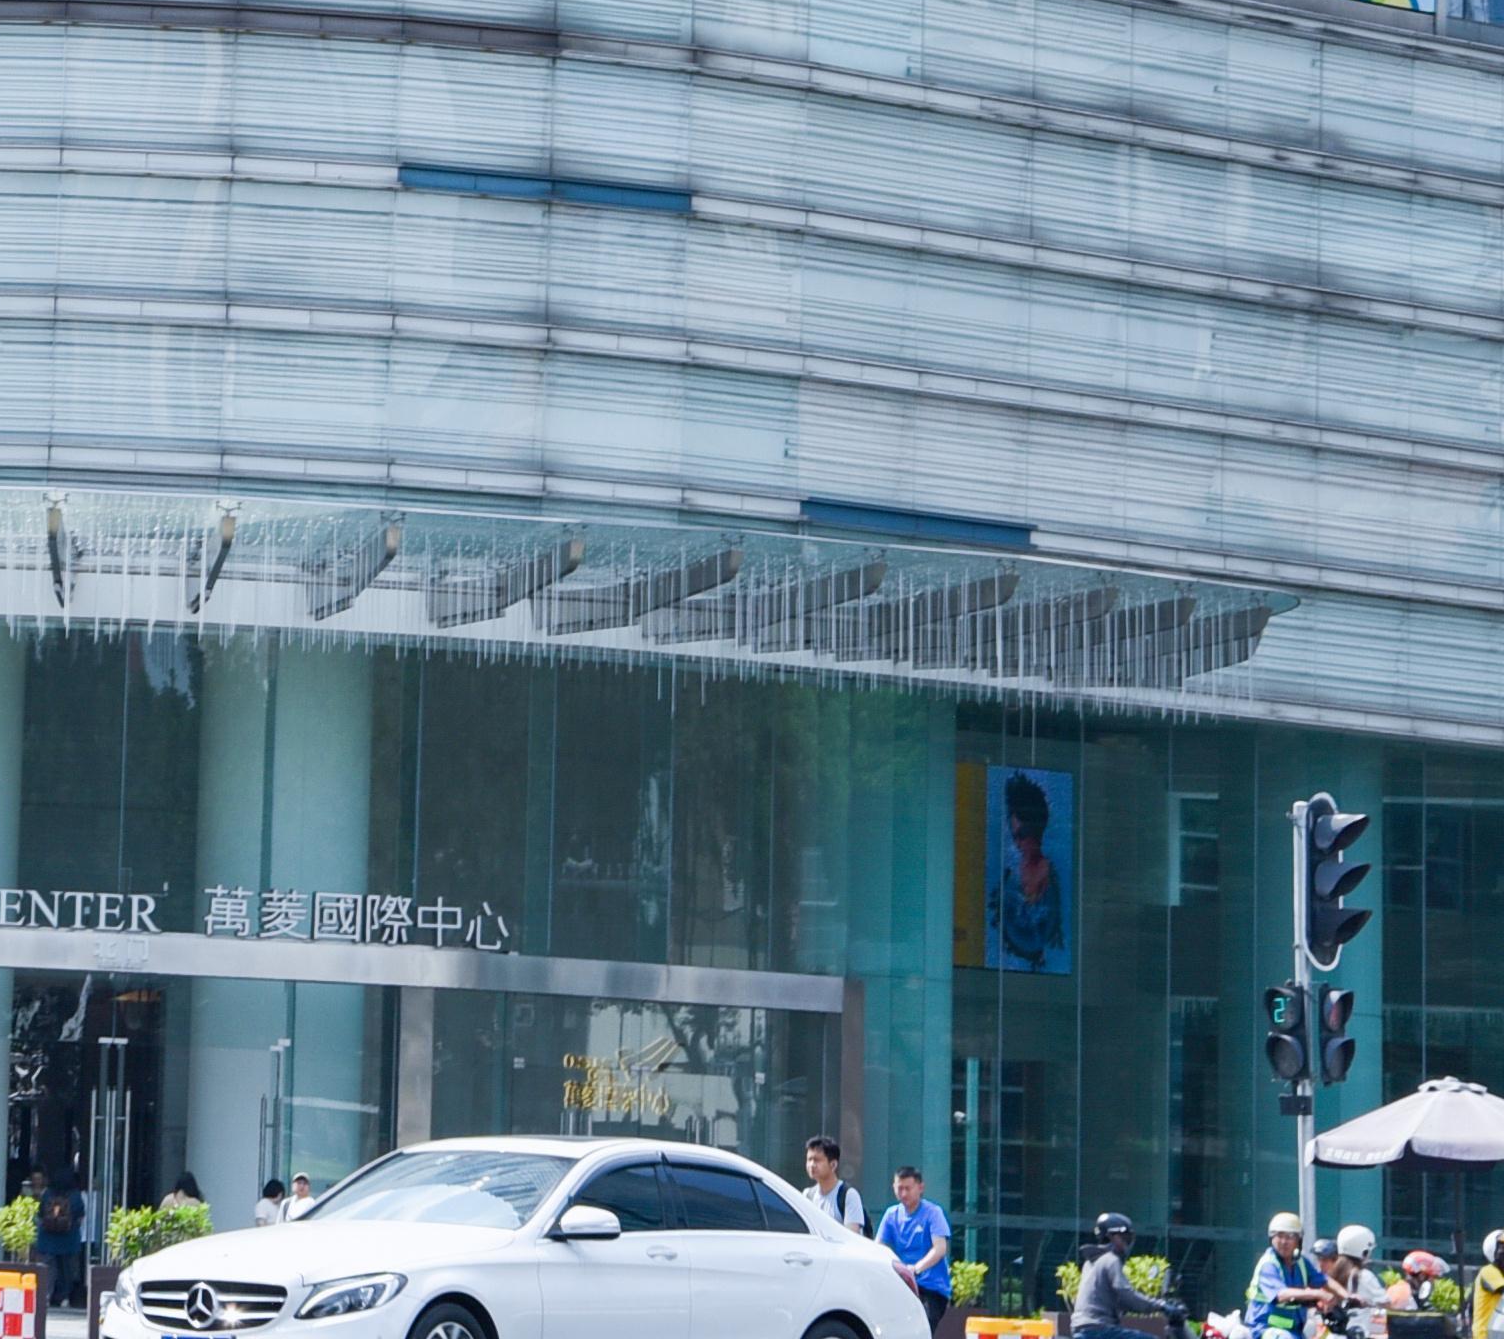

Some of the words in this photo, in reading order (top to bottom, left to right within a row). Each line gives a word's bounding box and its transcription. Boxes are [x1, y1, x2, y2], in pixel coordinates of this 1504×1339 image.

[203, 883, 510, 952] 萬菱國際中心
